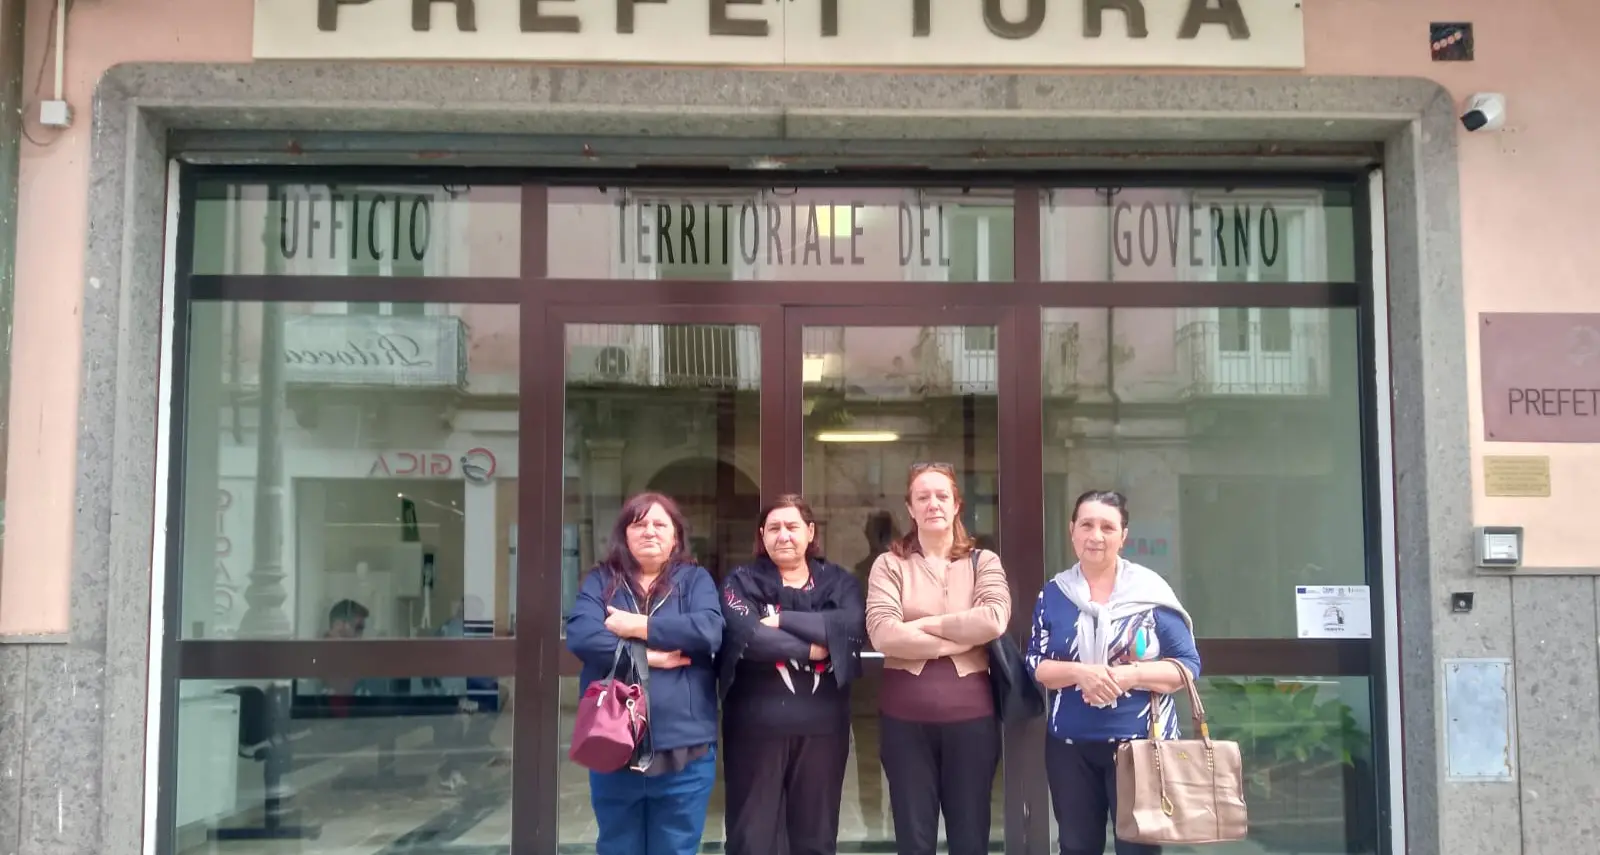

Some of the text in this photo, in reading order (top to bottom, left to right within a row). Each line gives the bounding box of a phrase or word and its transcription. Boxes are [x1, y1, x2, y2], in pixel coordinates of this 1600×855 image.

[279, 193, 1280, 268] UFFICIO TERRITORIALE DEL GOVERNO
[1508, 388, 1600, 417] PREFET
